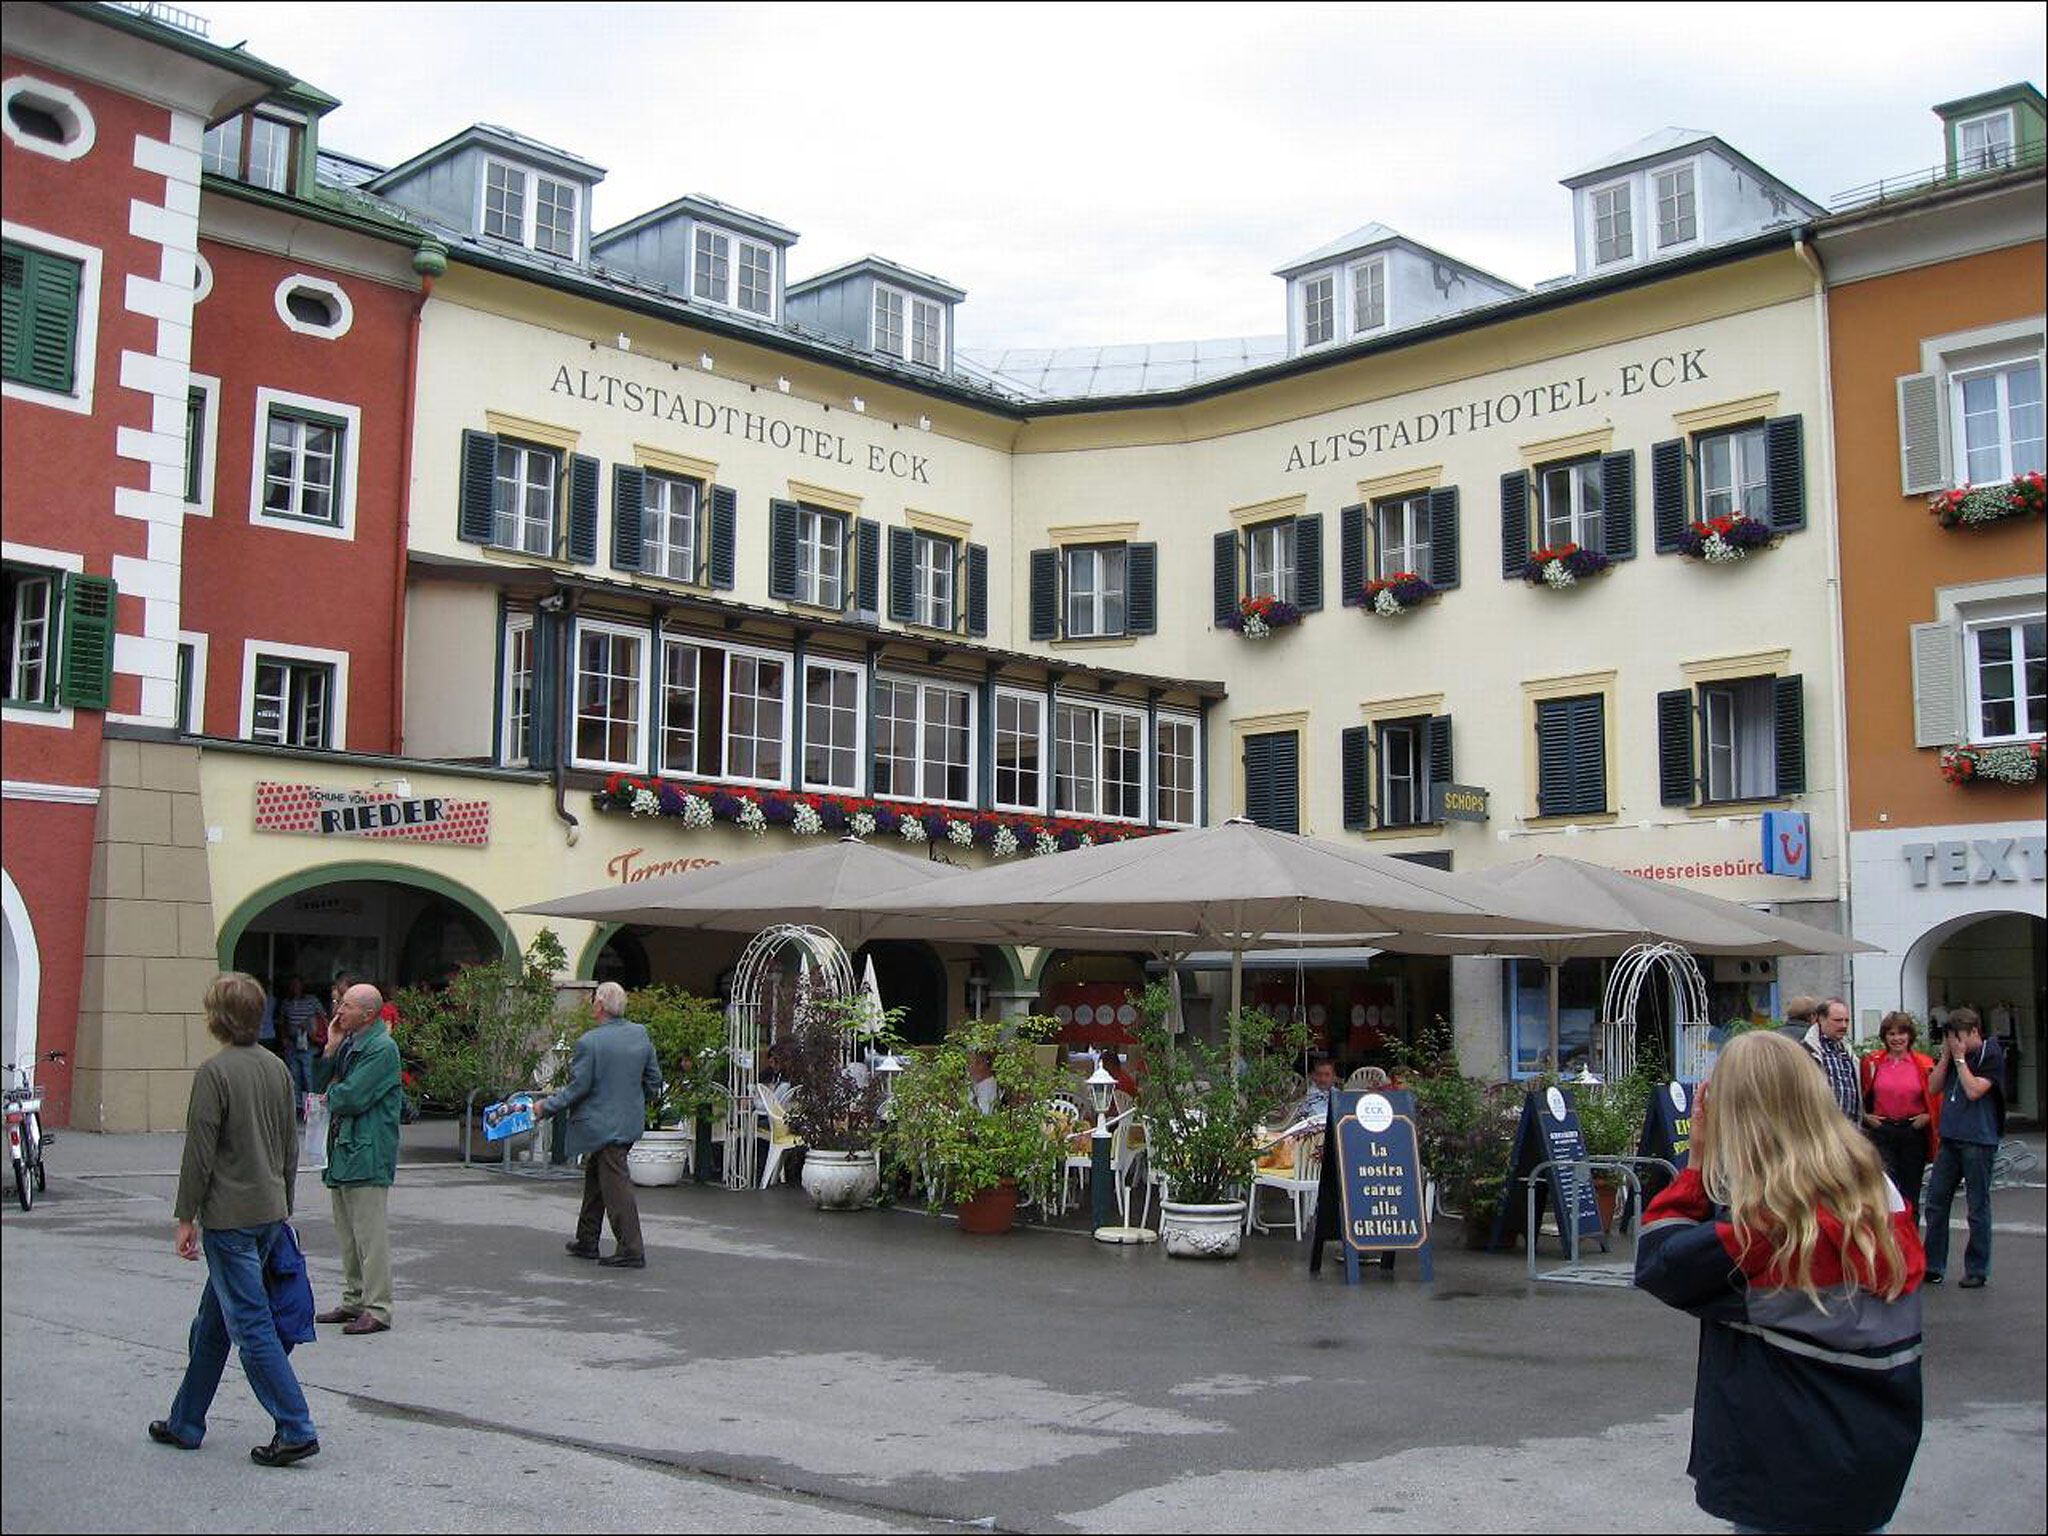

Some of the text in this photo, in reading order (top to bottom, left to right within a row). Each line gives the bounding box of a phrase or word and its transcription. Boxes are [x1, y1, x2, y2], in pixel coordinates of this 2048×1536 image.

[1284, 348, 1709, 473] ALTSTADTHOTEL ECK
[551, 364, 931, 485] ALTSTADTHOTEL ECK
[308, 790, 368, 805] SCHUHE VON
[320, 798, 444, 834] RIEDER
[1370, 1142, 1388, 1156] La
[1359, 1164, 1404, 1177] nostra
[1363, 1184, 1403, 1197] carne
[1371, 1201, 1399, 1216] alla
[1354, 1219, 1418, 1237] GRIGLIA
